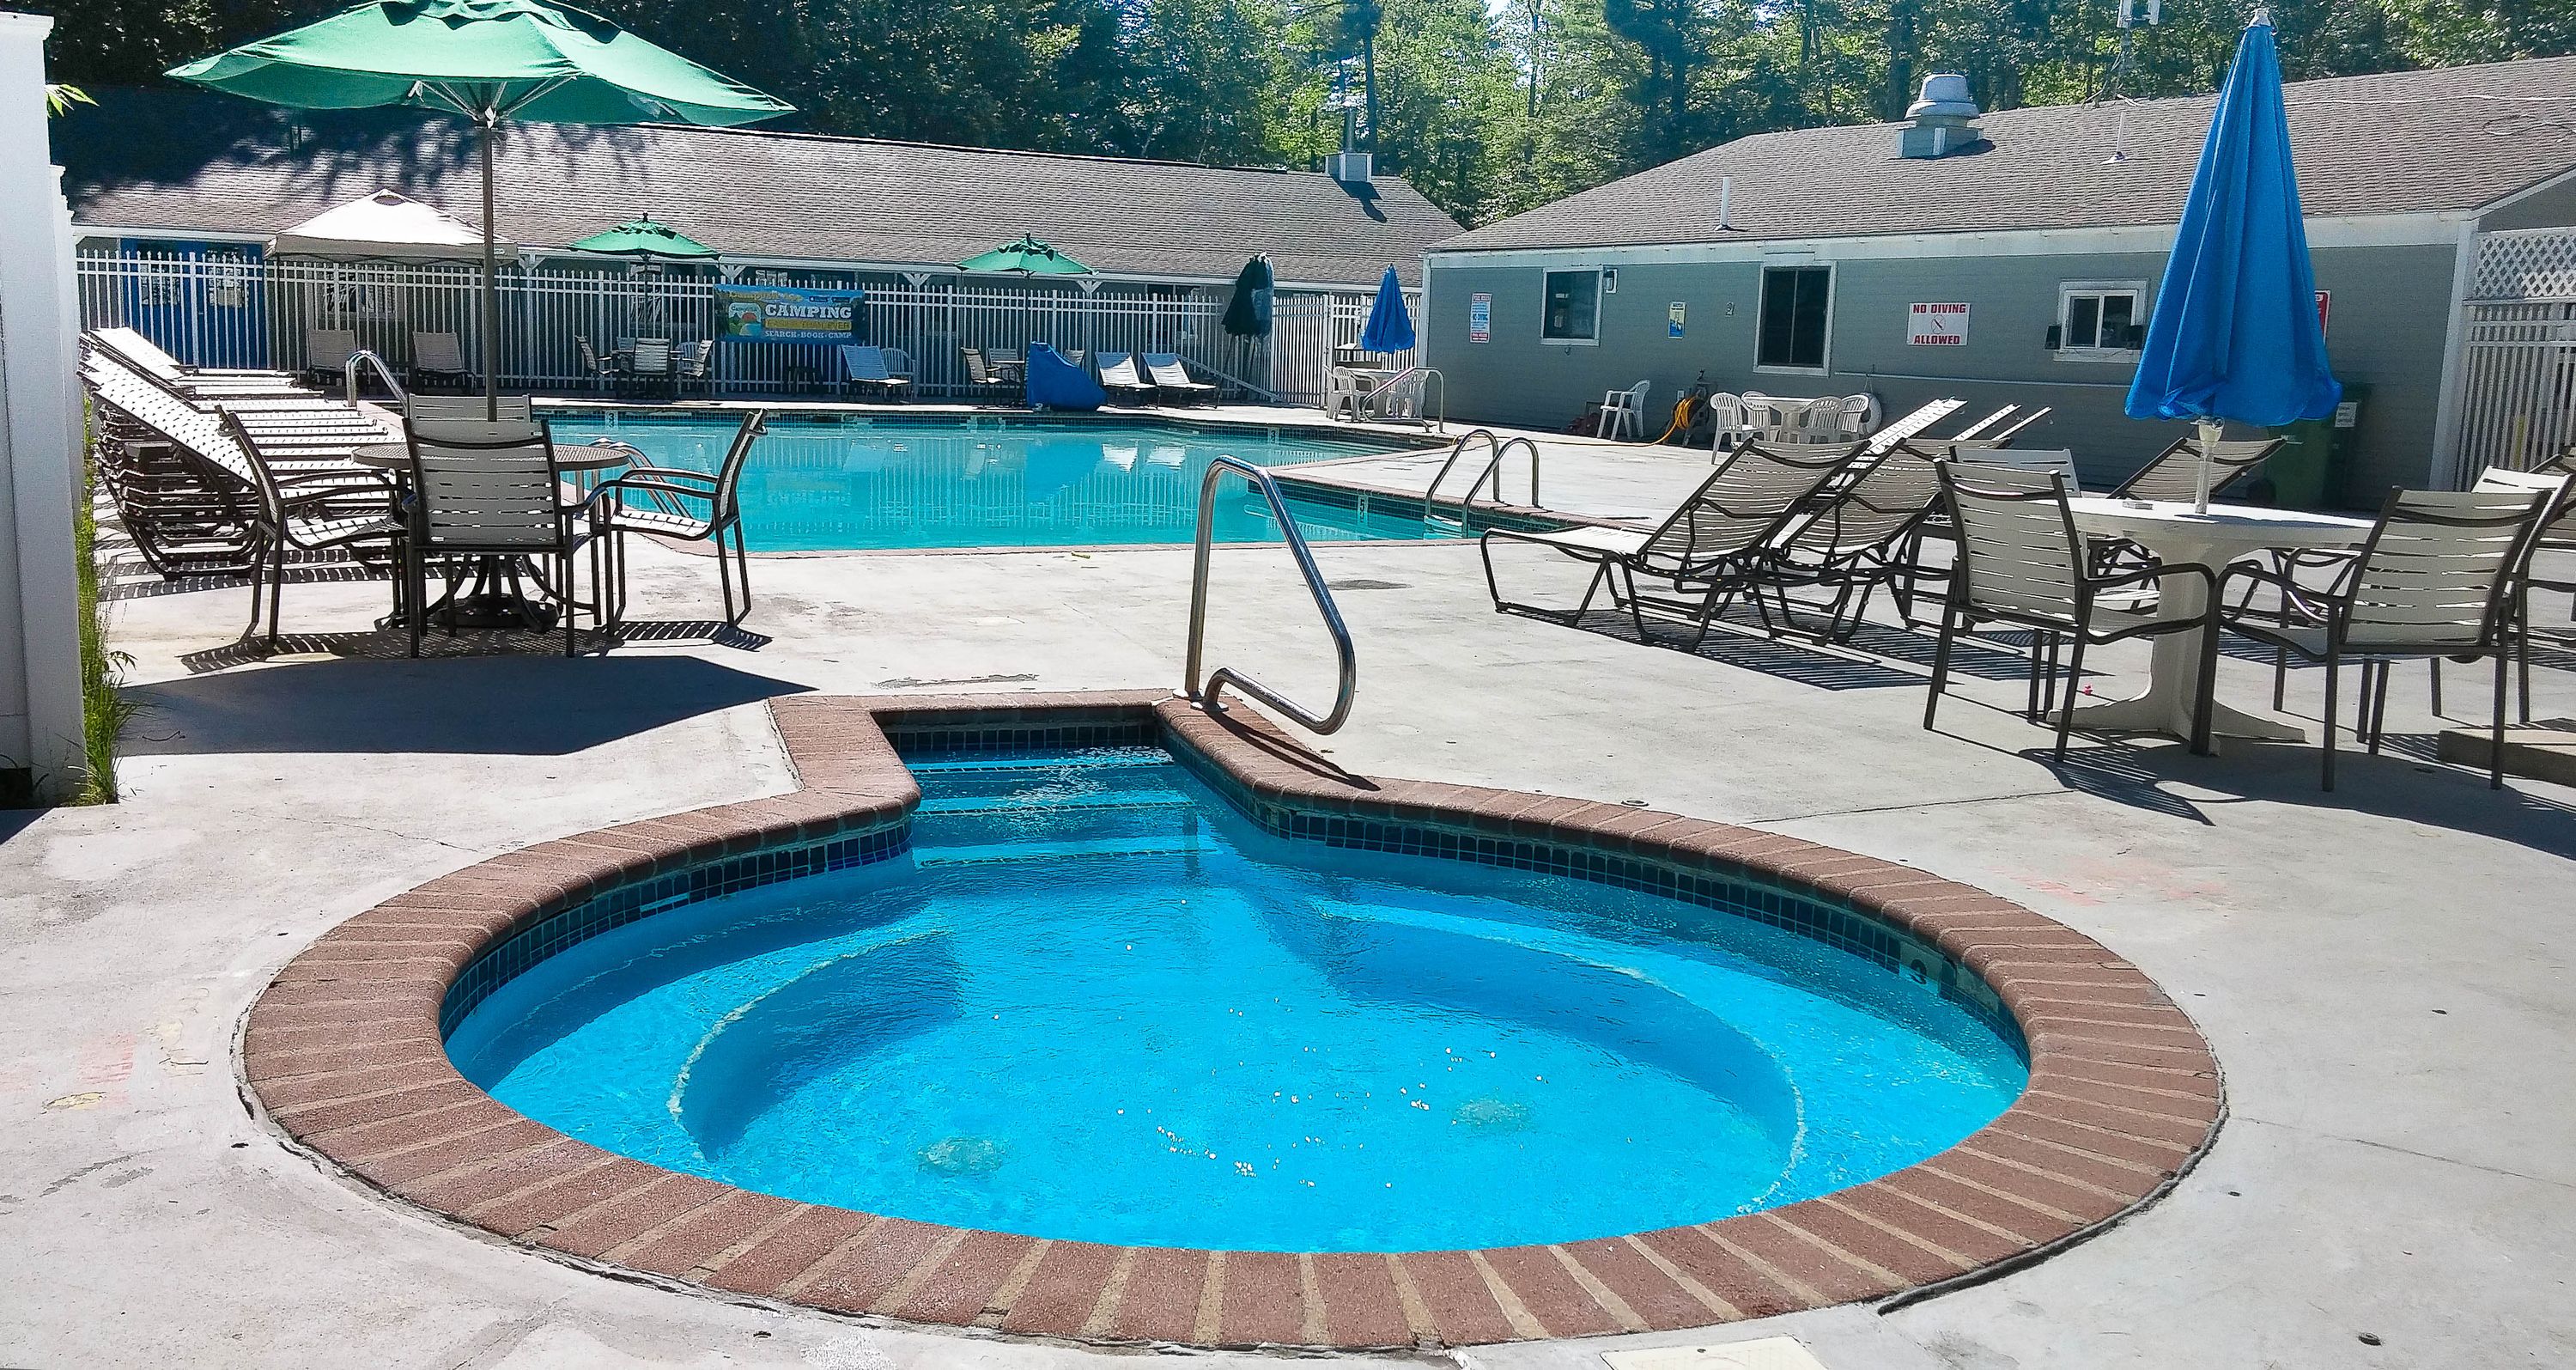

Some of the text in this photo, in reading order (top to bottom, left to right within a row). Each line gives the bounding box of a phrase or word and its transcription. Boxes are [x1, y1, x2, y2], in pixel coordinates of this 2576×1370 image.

[765, 303, 852, 319] CAMPING
[1913, 303, 1966, 314] NO DIVING
[1913, 335, 1960, 344] ALLOWED
